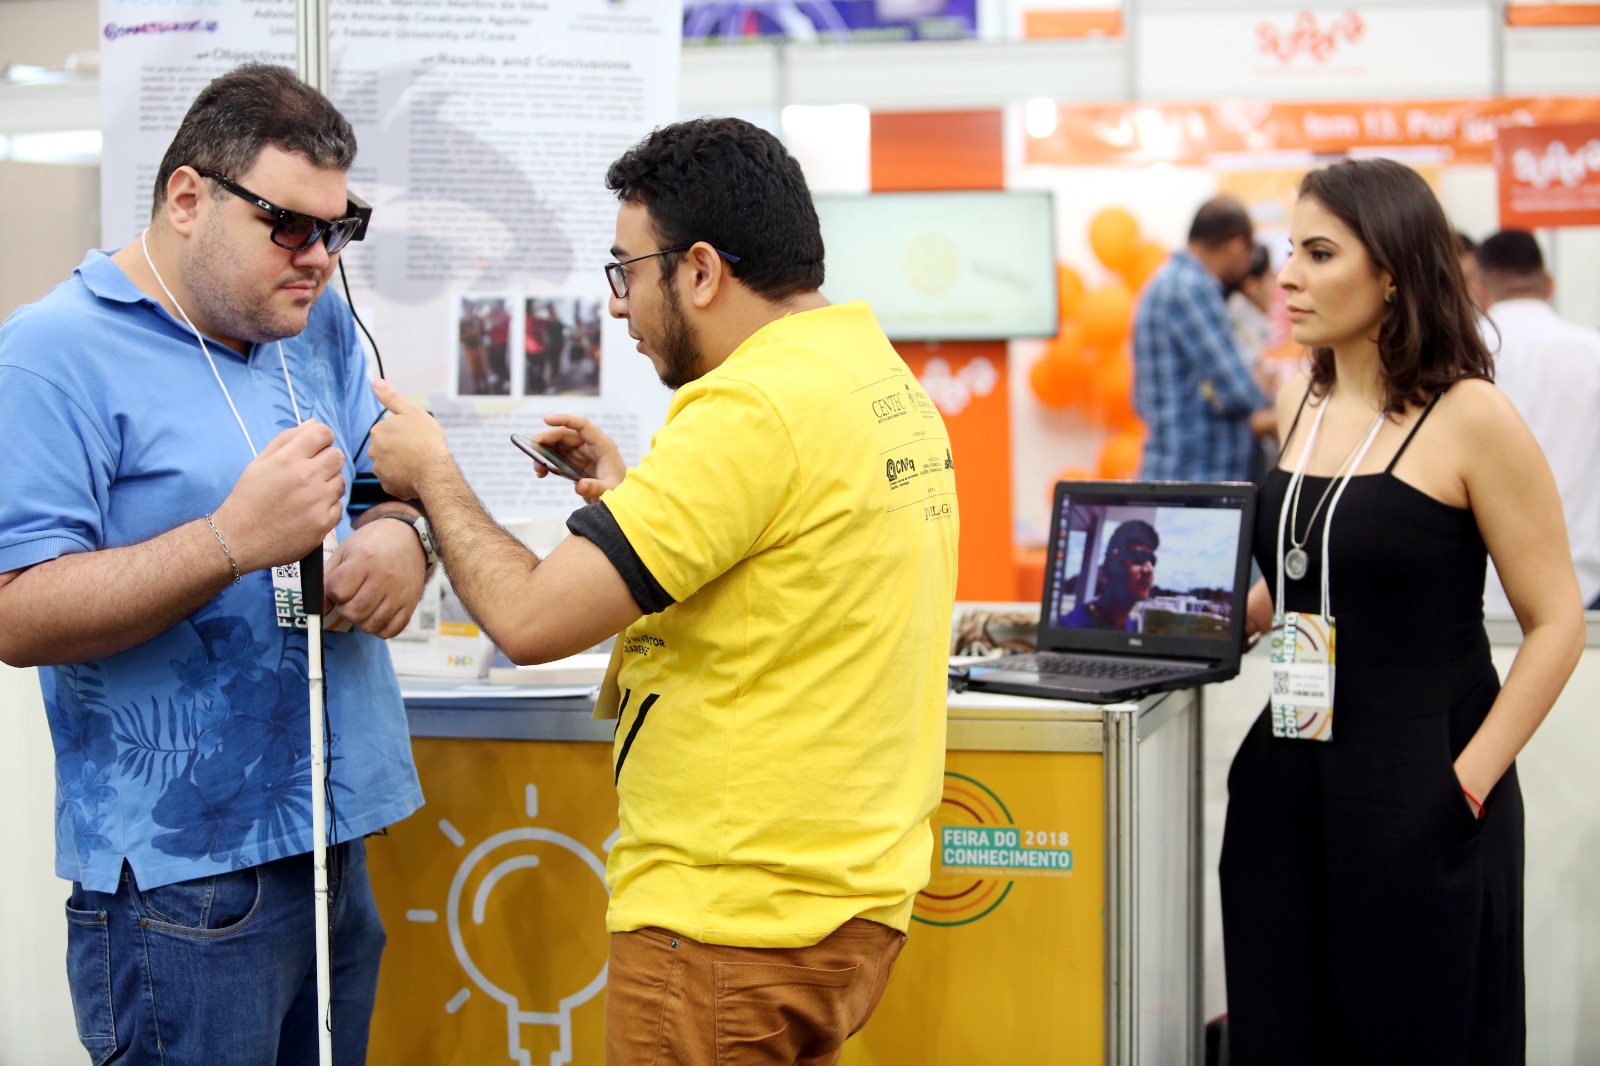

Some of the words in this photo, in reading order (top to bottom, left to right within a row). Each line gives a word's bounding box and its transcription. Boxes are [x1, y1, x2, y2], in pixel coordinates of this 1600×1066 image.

[436, 52, 496, 67] Results
[502, 55, 531, 67] and
[534, 54, 633, 71] Conclusions
[871, 392, 907, 419] CENTEC
[273, 587, 292, 628] FEIR
[943, 829, 990, 847] FEIRA
[994, 830, 1017, 847] DO
[1024, 831, 1070, 847] 2018
[943, 848, 1070, 868] CONHECIMENTO
